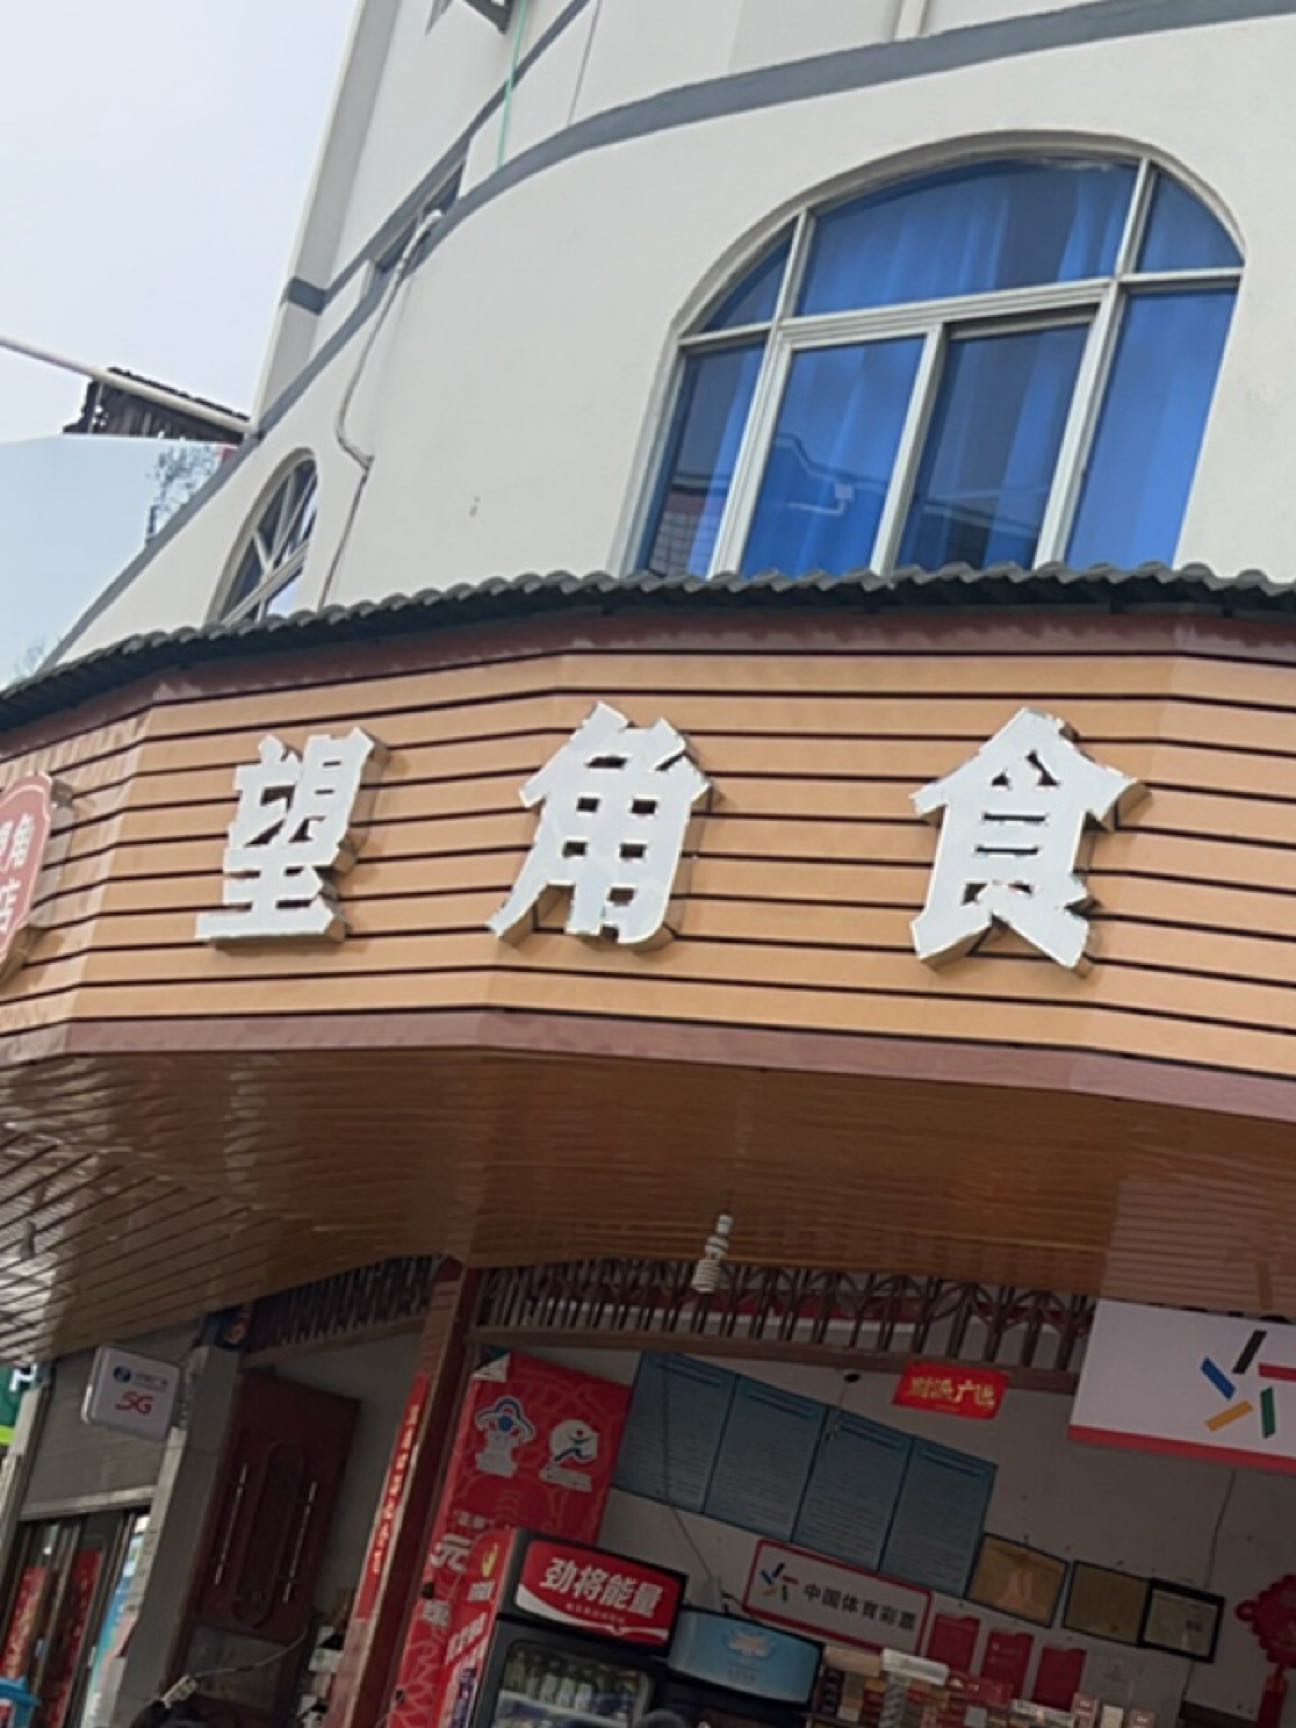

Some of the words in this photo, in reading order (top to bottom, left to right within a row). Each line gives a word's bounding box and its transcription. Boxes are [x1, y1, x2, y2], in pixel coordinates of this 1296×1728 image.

[115, 1390, 154, 1416] 5G
[541, 1556, 665, 1619] 劲将能量
[804, 1583, 917, 1631] 中国体育彩票
